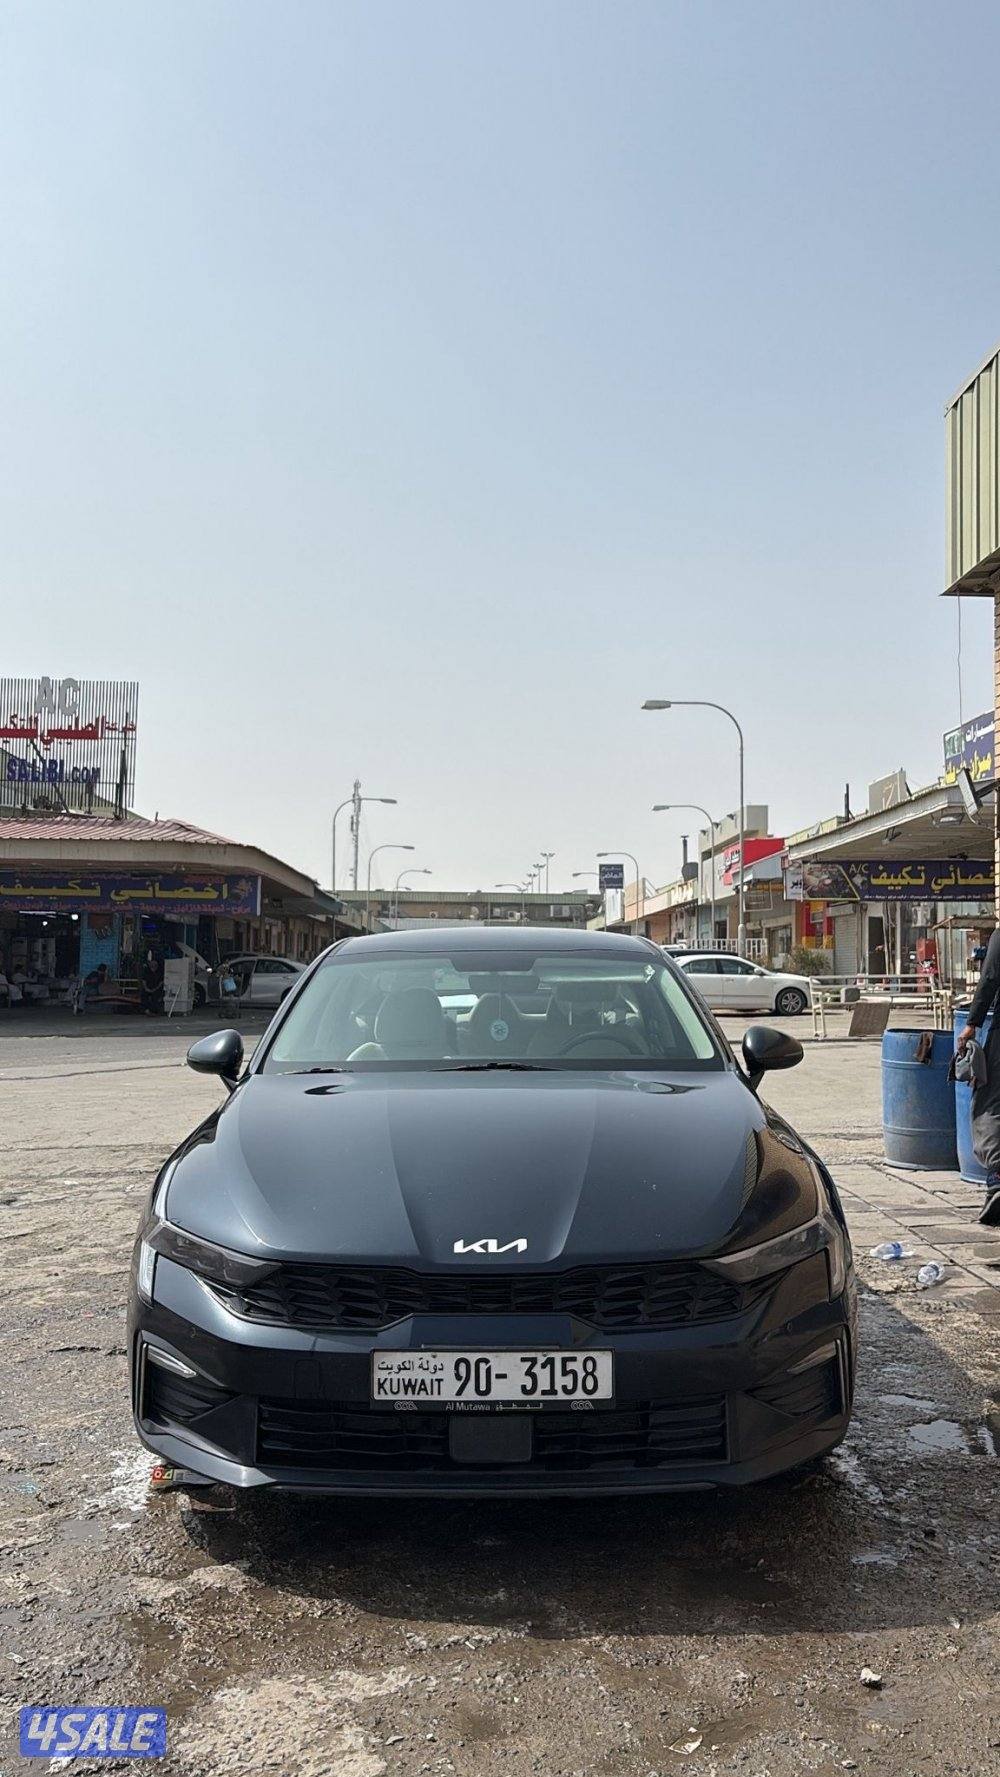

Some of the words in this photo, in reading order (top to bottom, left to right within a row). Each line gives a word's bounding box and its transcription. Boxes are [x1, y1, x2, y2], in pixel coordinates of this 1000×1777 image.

[34, 676, 80, 716] AC
[849, 863, 869, 874] A/C
[870, 864, 925, 890] تكييف
[0, 879, 101, 900] تكييف
[110, 880, 229, 904] اخصائي
[453, 1238, 528, 1254] KIA
[377, 1360, 414, 1375] الكويت
[418, 1357, 444, 1374] دولة
[520, 1356, 598, 1396] 3158
[377, 1378, 444, 1396] KUWAIT
[456, 1402, 491, 1411] Mutawa
